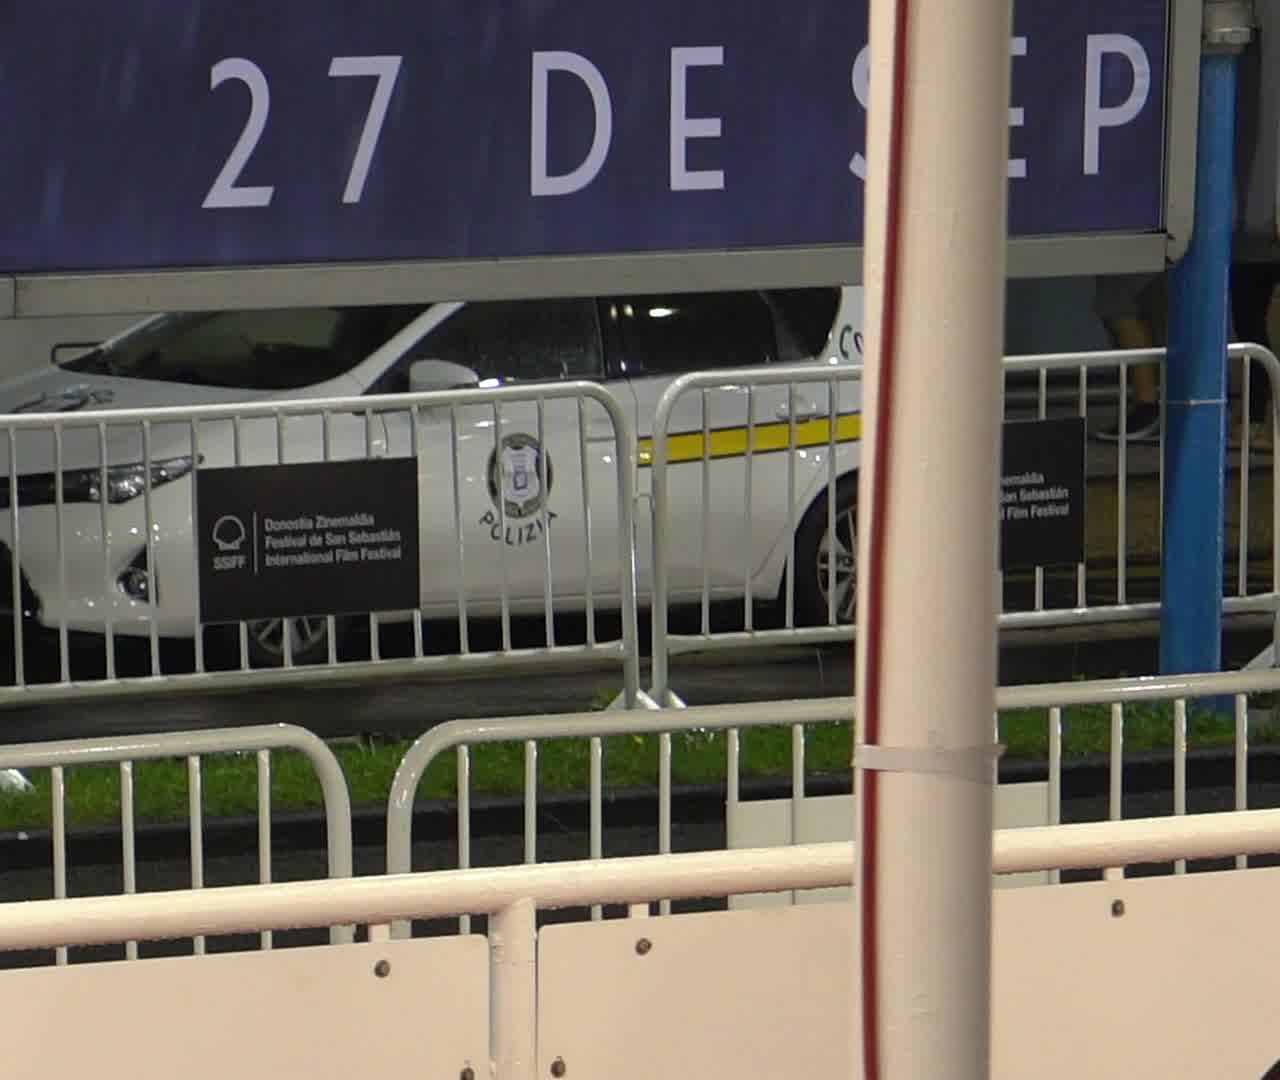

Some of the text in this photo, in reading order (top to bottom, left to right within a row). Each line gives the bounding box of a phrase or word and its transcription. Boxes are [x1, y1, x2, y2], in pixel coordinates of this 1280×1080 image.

[531, 45, 725, 197] DE
[263, 513, 375, 533] Donostia Zinemaldia
[264, 534, 307, 550] Festival
[309, 533, 323, 547] de
[325, 532, 346, 546] San
[264, 545, 402, 567] International Film Festival
